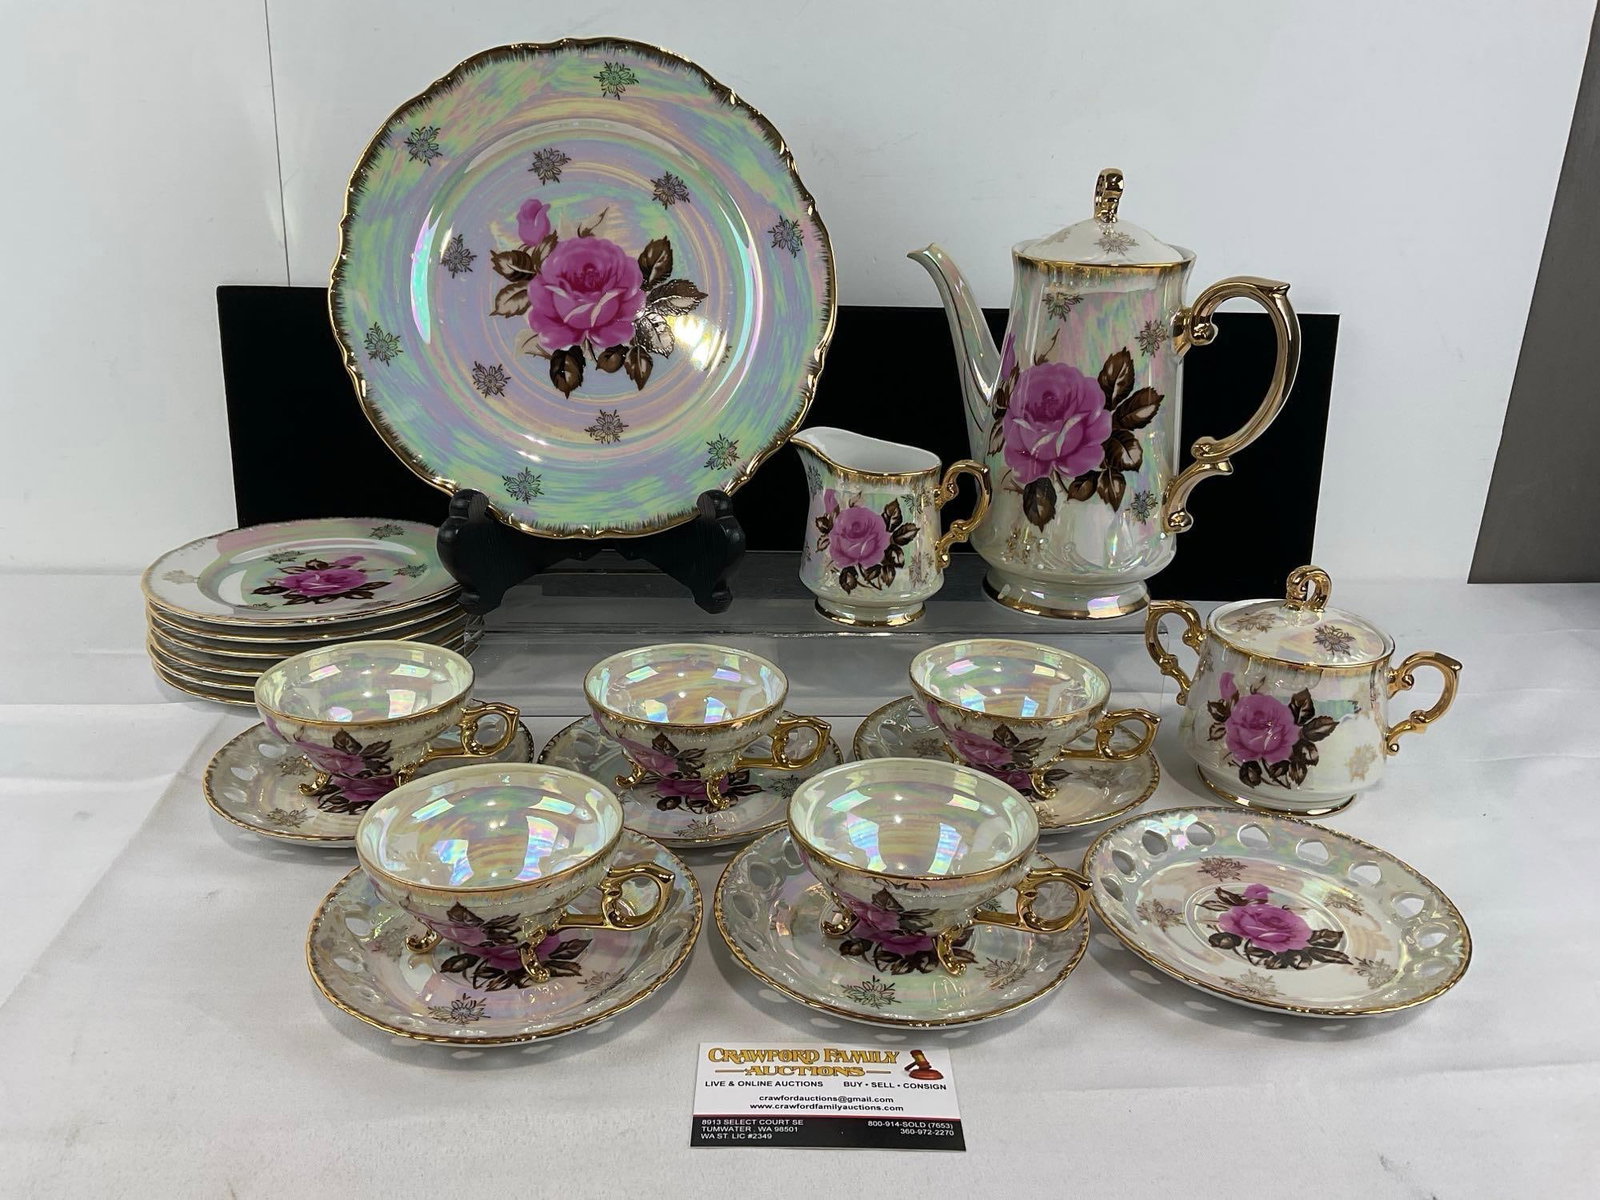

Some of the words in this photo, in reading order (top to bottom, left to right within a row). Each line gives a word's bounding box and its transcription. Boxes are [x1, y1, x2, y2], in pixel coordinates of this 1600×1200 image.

[708, 1047, 820, 1064] CRAWFORD
[823, 1048, 900, 1064] FAMILY
[745, 1065, 866, 1077] AUCTIONS
[903, 1082, 947, 1090] CONSIGN
[759, 1095, 894, 1103] crawfordauctions@gmail.com
[750, 1103, 904, 1111] www.crawfordfamilyauctions.com
[867, 1120, 926, 1128] 800-914-SOLD
[900, 1128, 955, 1136] 360-972-2270
